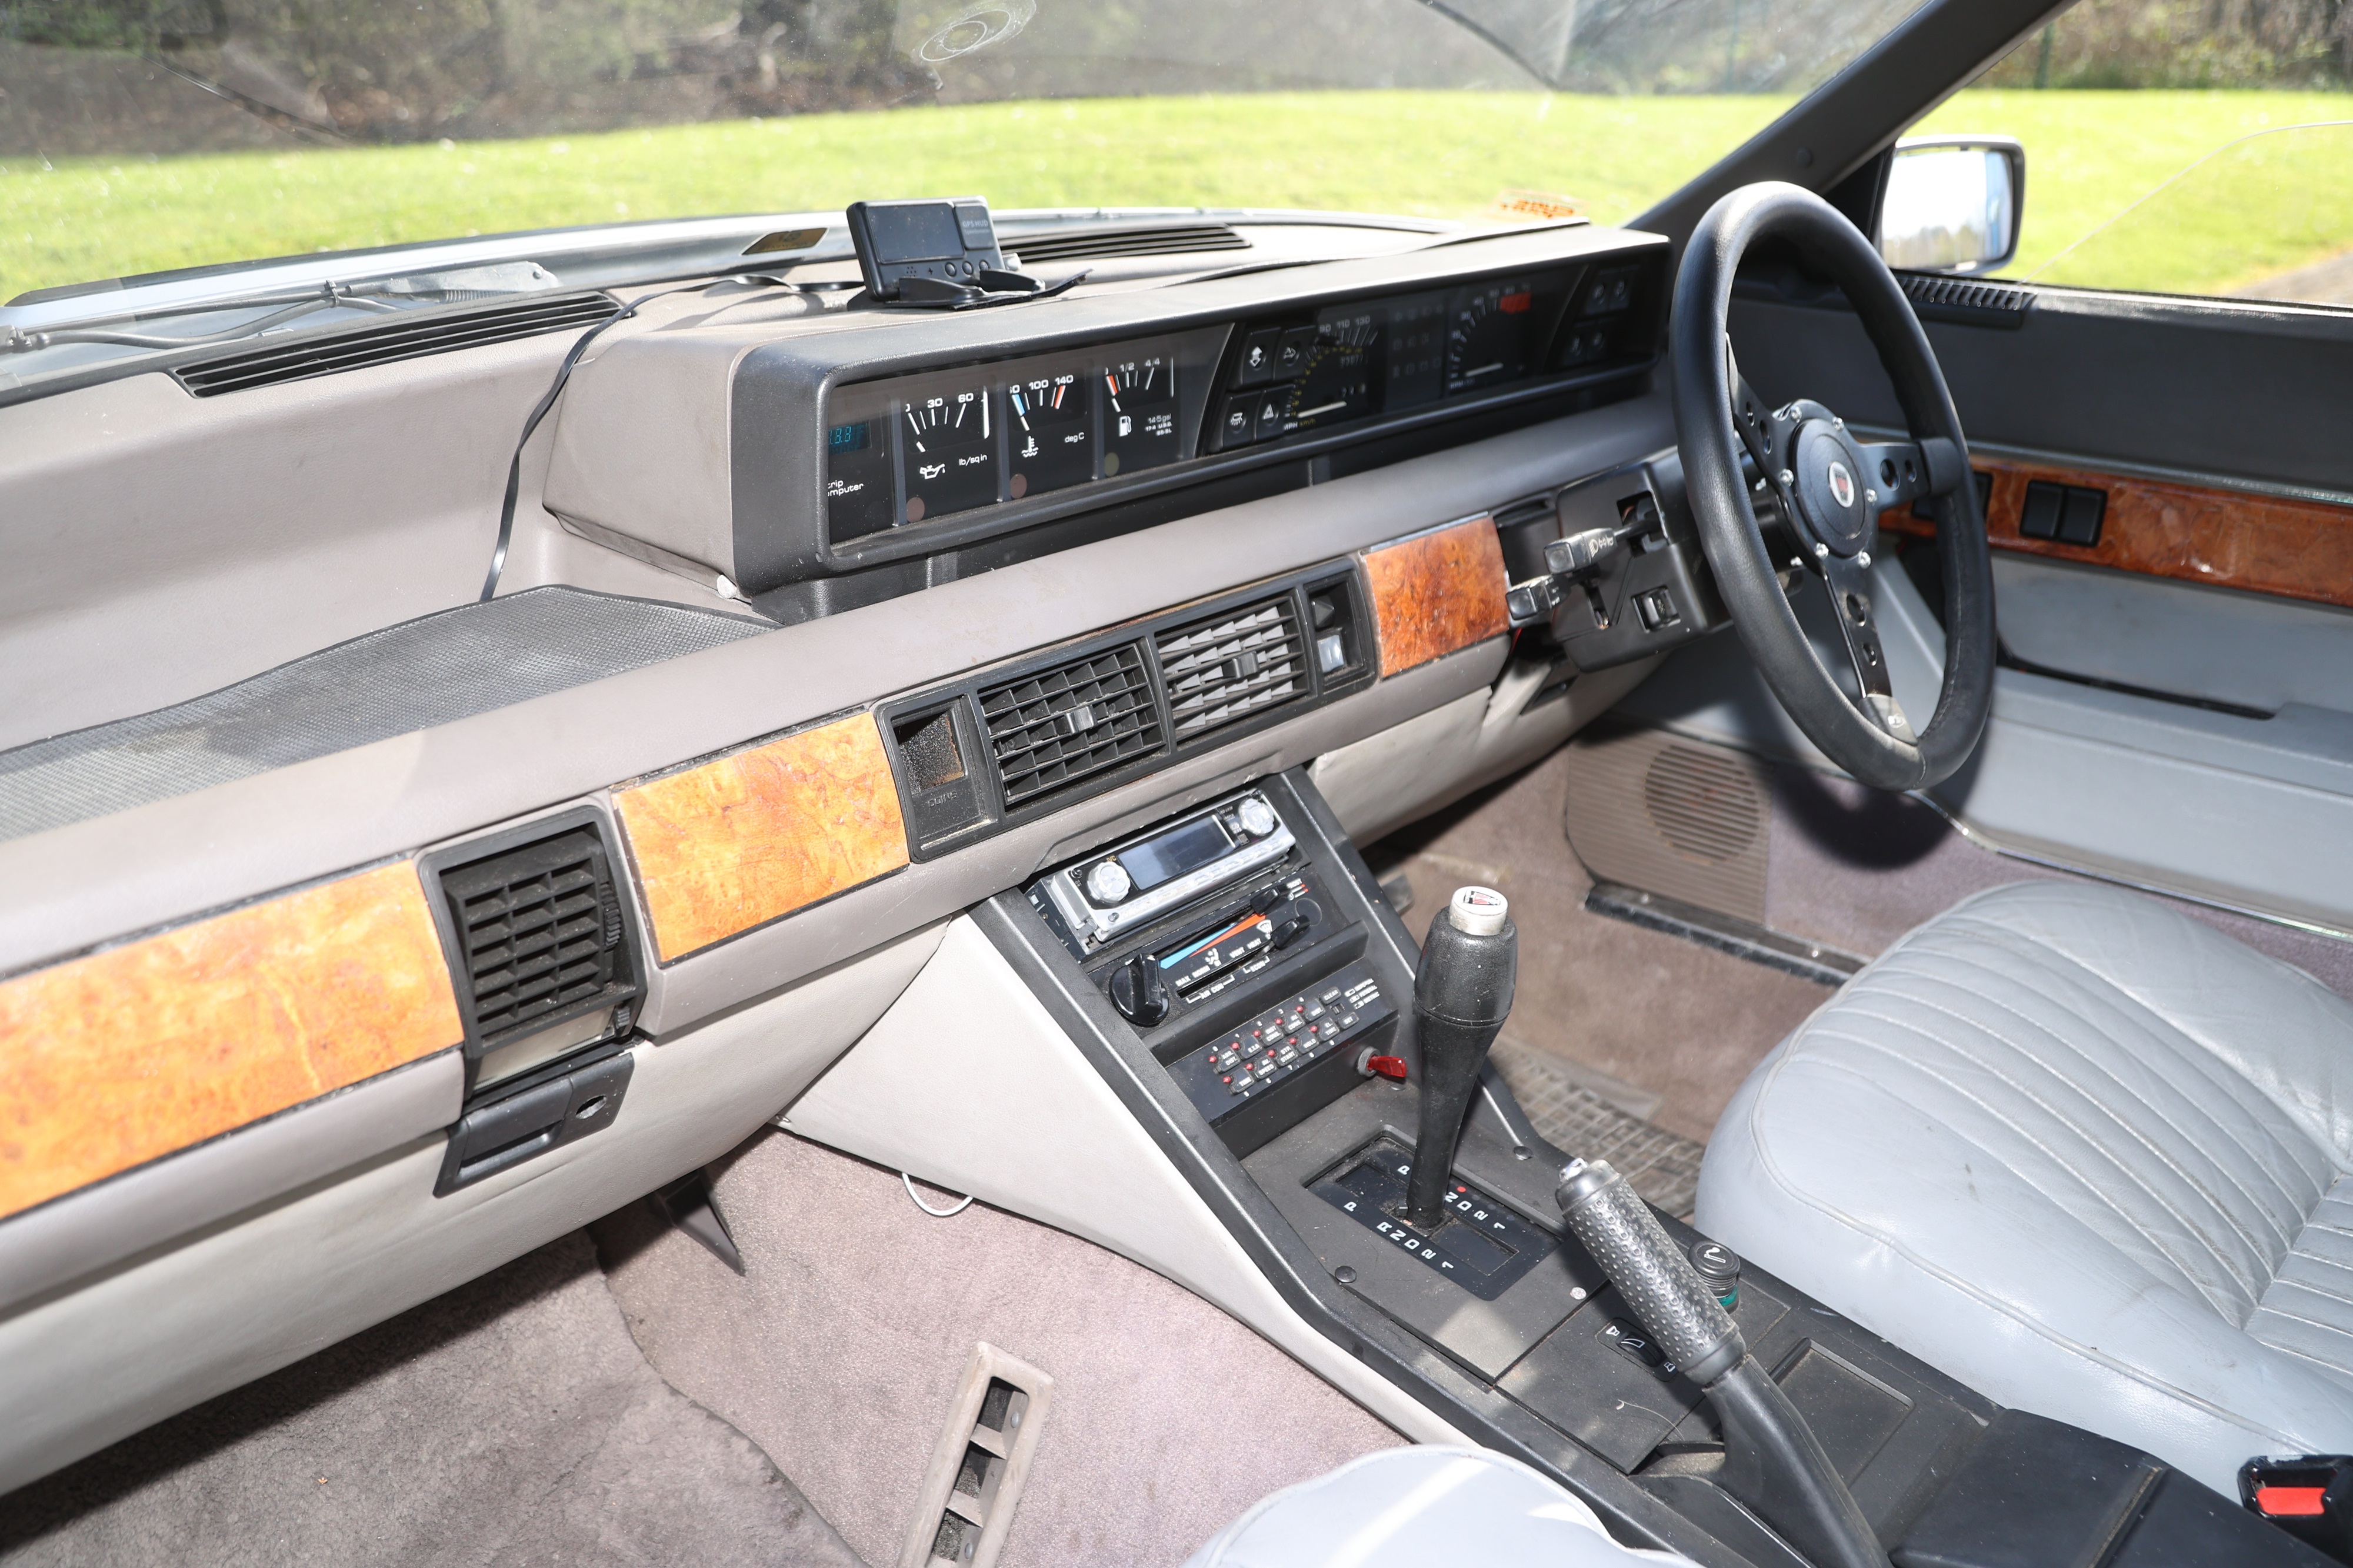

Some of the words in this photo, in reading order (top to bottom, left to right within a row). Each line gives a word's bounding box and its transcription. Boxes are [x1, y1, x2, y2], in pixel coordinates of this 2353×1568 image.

[1337, 319, 1350, 328] 110
[1119, 362, 1135, 372] 1/2
[1145, 358, 1161, 367] 4/4
[1028, 379, 1049, 390] 100
[1055, 375, 1074, 385] 140
[927, 398, 943, 408] 30
[958, 392, 974, 403] 60
[1065, 435, 1078, 443] deg
[1078, 432, 1085, 440] C
[928, 790, 958, 808] COINS
[1175, 975, 1191, 987] MAX
[1192, 965, 1211, 978] NORM
[1229, 947, 1245, 958] VENT
[1247, 938, 1262, 949] HEAT
[1250, 960, 1266, 972] ECON
[1354, 978, 1374, 992] IMPERIAL
[1199, 990, 1211, 999] AIR
[1211, 983, 1224, 993] CON
[1324, 990, 1338, 1000] CLEAR
[1359, 985, 1378, 997] FEDERAL
[1364, 992, 1379, 1003] METRIC
[1344, 1016, 1353, 1025] SET
[1325, 1026, 1337, 1035] TIME
[1304, 1039, 1316, 1048] HOLD
[1281, 1051, 1295, 1063] START
[1258, 1064, 1274, 1075] SPEED
[1239, 1076, 1252, 1086] TIME
[1397, 1165, 1410, 1175] P
[1445, 1192, 1459, 1203] N
[1457, 1200, 1472, 1211] D
[1474, 1210, 1488, 1220] 2
[1344, 1202, 1357, 1212] P
[1377, 1222, 1392, 1232] R
[1389, 1229, 1407, 1241] N
[1404, 1239, 1420, 1250] D
[1421, 1249, 1437, 1259] 2
